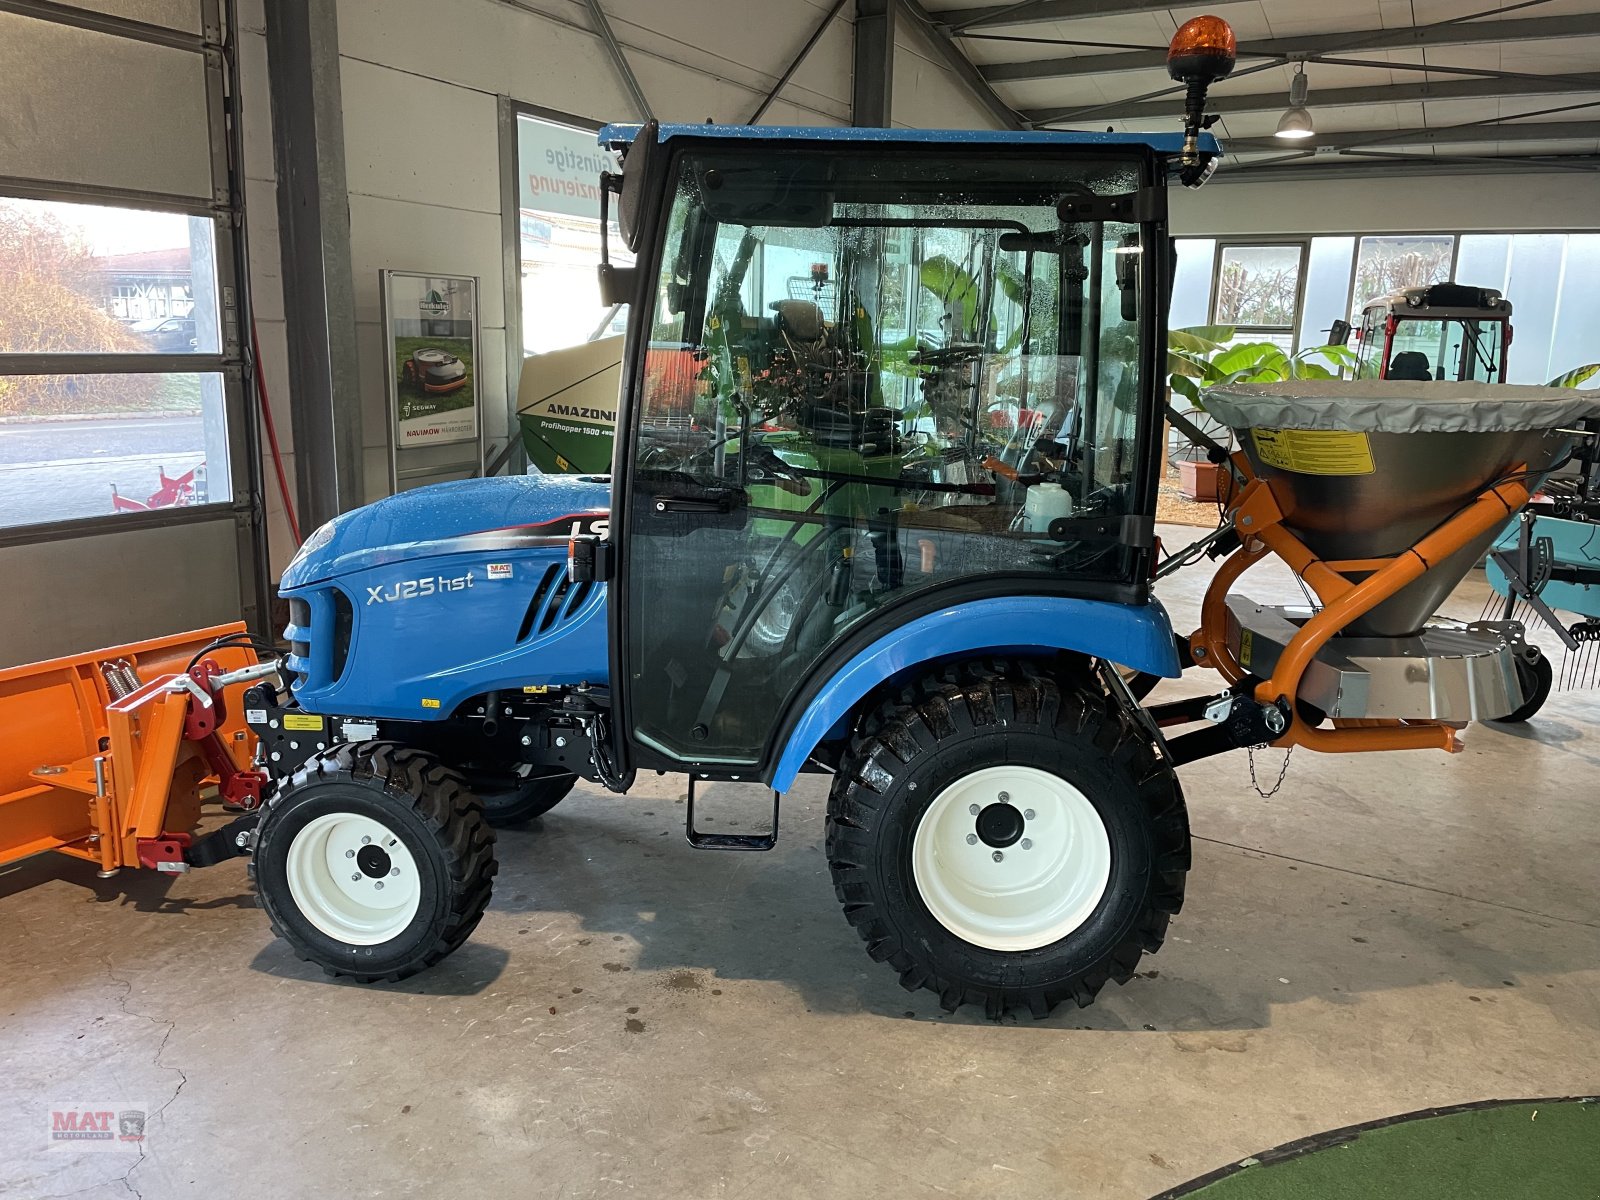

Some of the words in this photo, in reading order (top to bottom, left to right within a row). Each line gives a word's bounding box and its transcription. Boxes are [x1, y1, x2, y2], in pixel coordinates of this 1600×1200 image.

[406, 428, 440, 437] NAVIMOW
[540, 421, 581, 433] Profihopper
[582, 427, 600, 436] 1500
